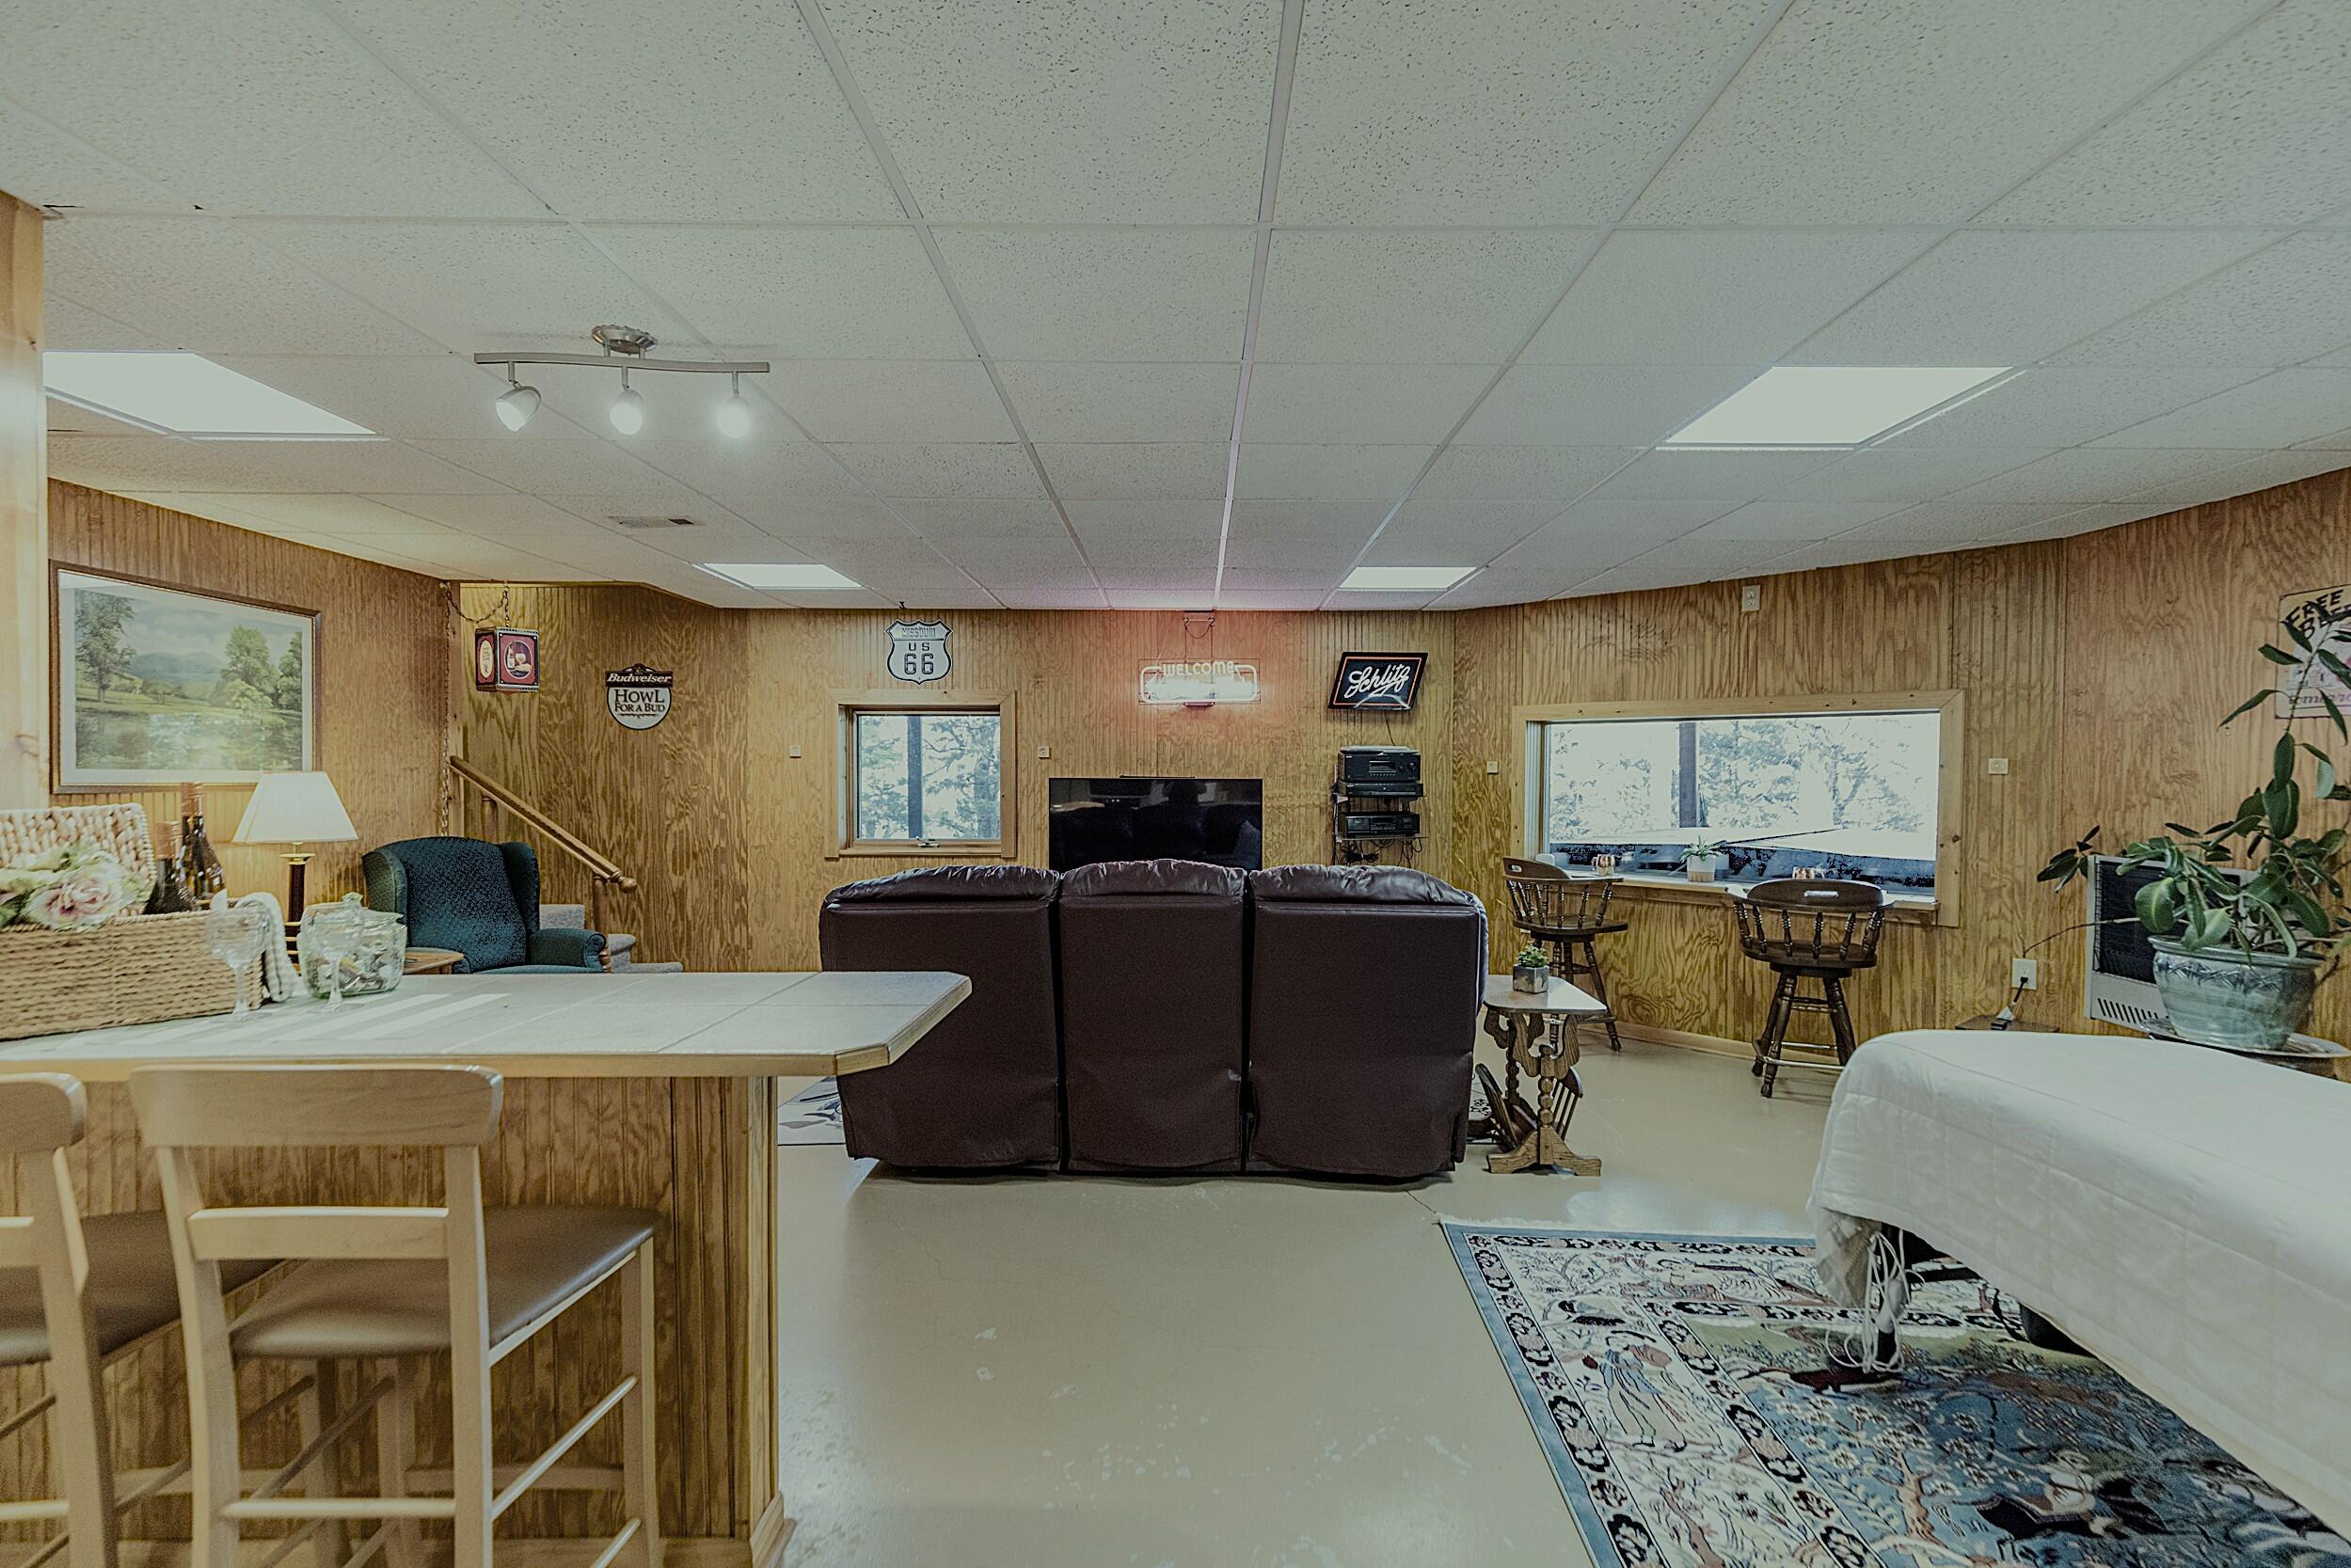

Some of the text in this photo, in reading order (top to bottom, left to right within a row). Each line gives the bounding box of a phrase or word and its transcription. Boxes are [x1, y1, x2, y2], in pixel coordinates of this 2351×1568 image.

[2285, 589, 2343, 625] FREE
[901, 626, 936, 639] MISSOURI
[908, 641, 930, 652] US
[904, 653, 934, 675] 66
[607, 673, 672, 683] Budweiser
[1343, 663, 1411, 698] Schlitz
[614, 689, 665, 703] HOWL
[614, 702, 666, 712] FOR A BUD
